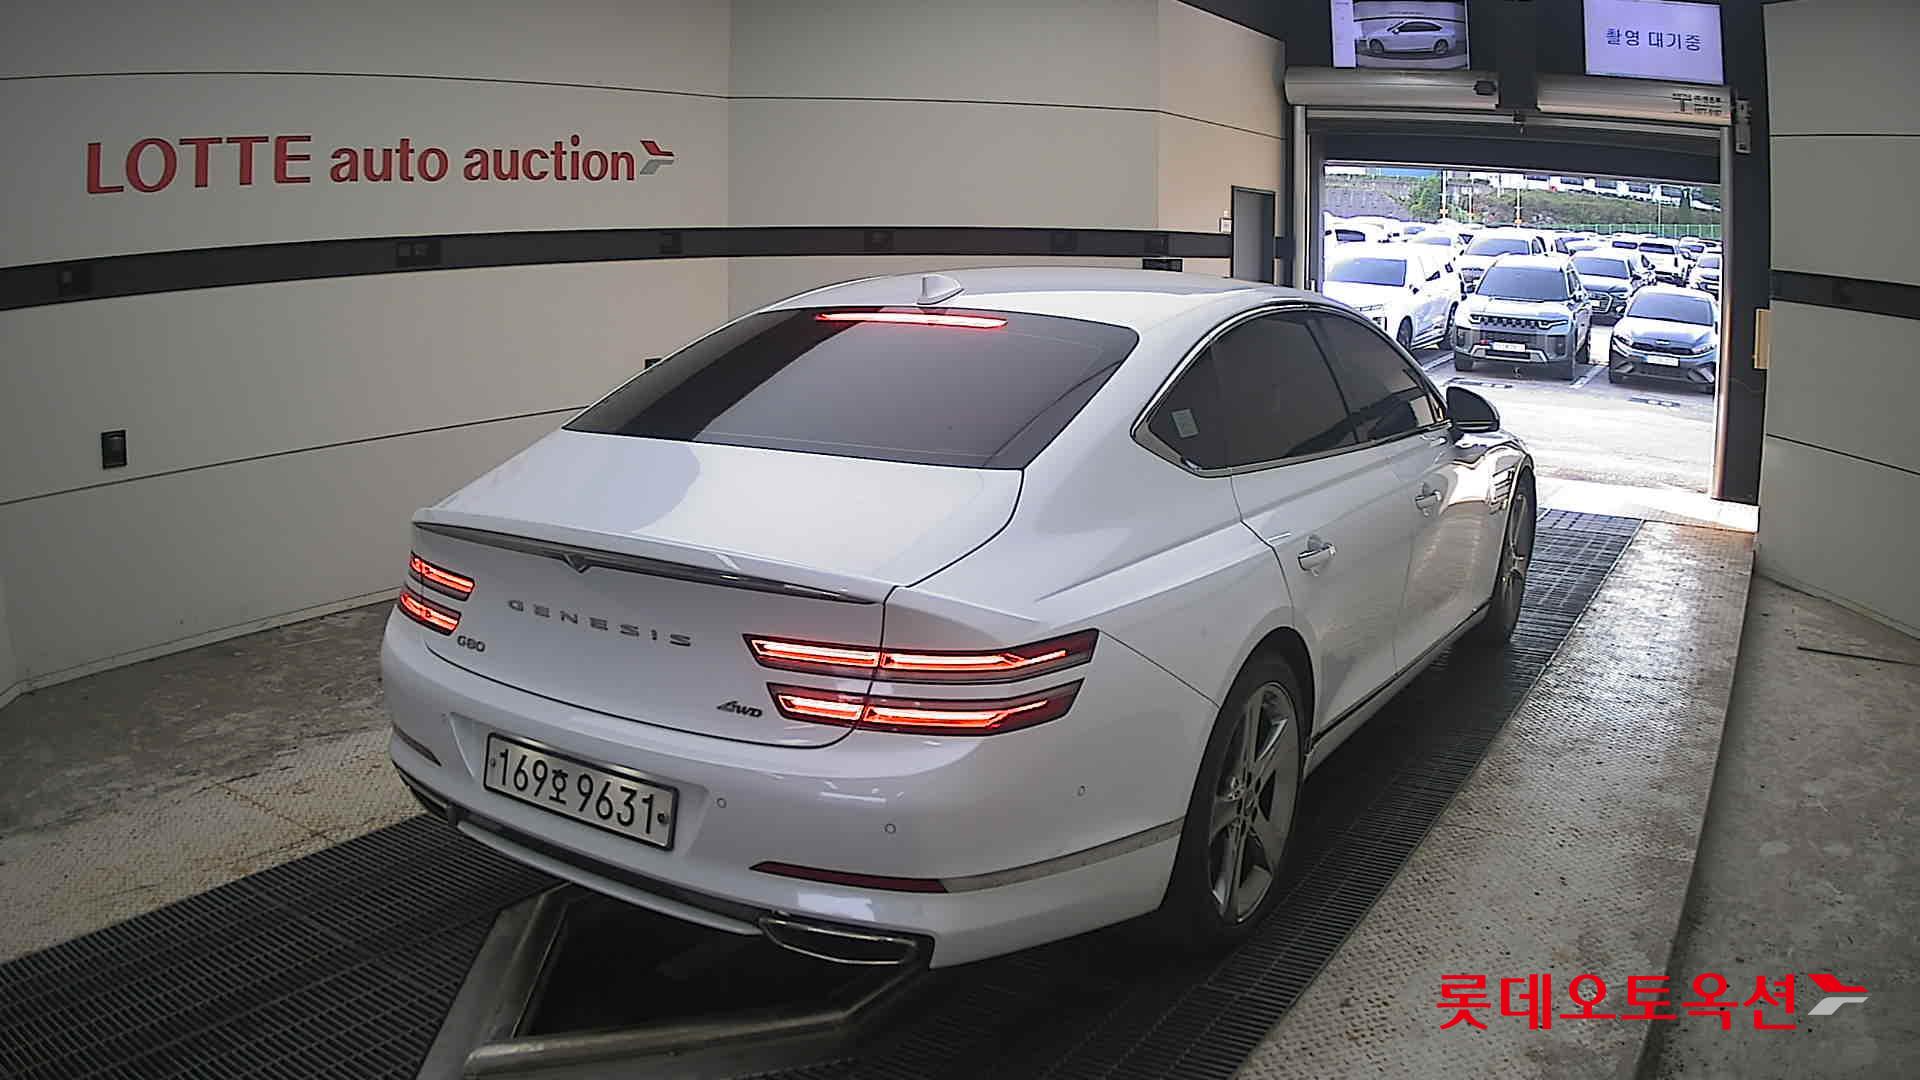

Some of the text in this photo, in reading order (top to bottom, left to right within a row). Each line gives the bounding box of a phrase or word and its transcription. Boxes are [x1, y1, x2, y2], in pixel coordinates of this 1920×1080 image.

[1648, 31, 1700, 52] 대기중
[86, 134, 635, 195] LOTTE auto auction
[508, 599, 692, 647] GENESIS
